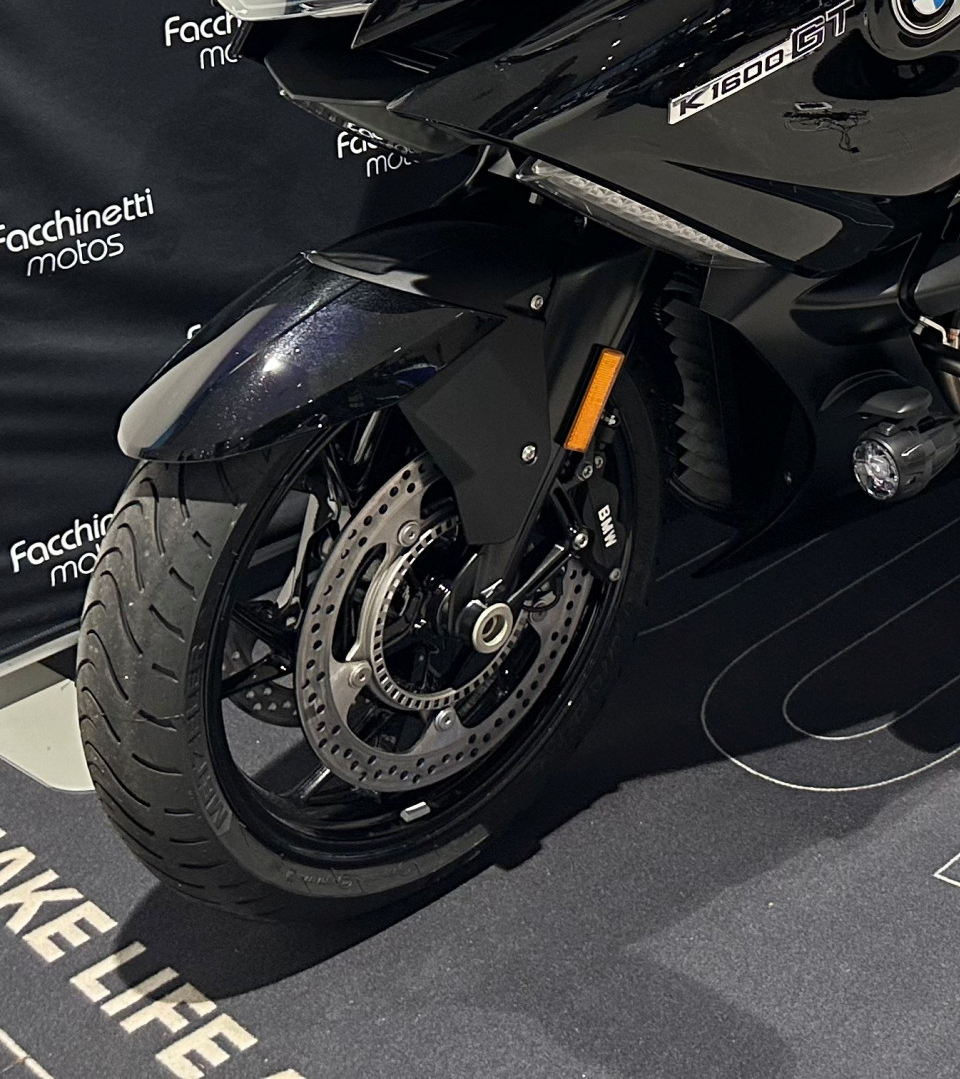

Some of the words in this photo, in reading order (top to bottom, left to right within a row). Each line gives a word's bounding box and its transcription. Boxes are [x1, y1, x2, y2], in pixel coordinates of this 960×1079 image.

[26, 232, 125, 277] motos
[597, 504, 618, 548] BMW
[70, 941, 258, 1079] LIFE
